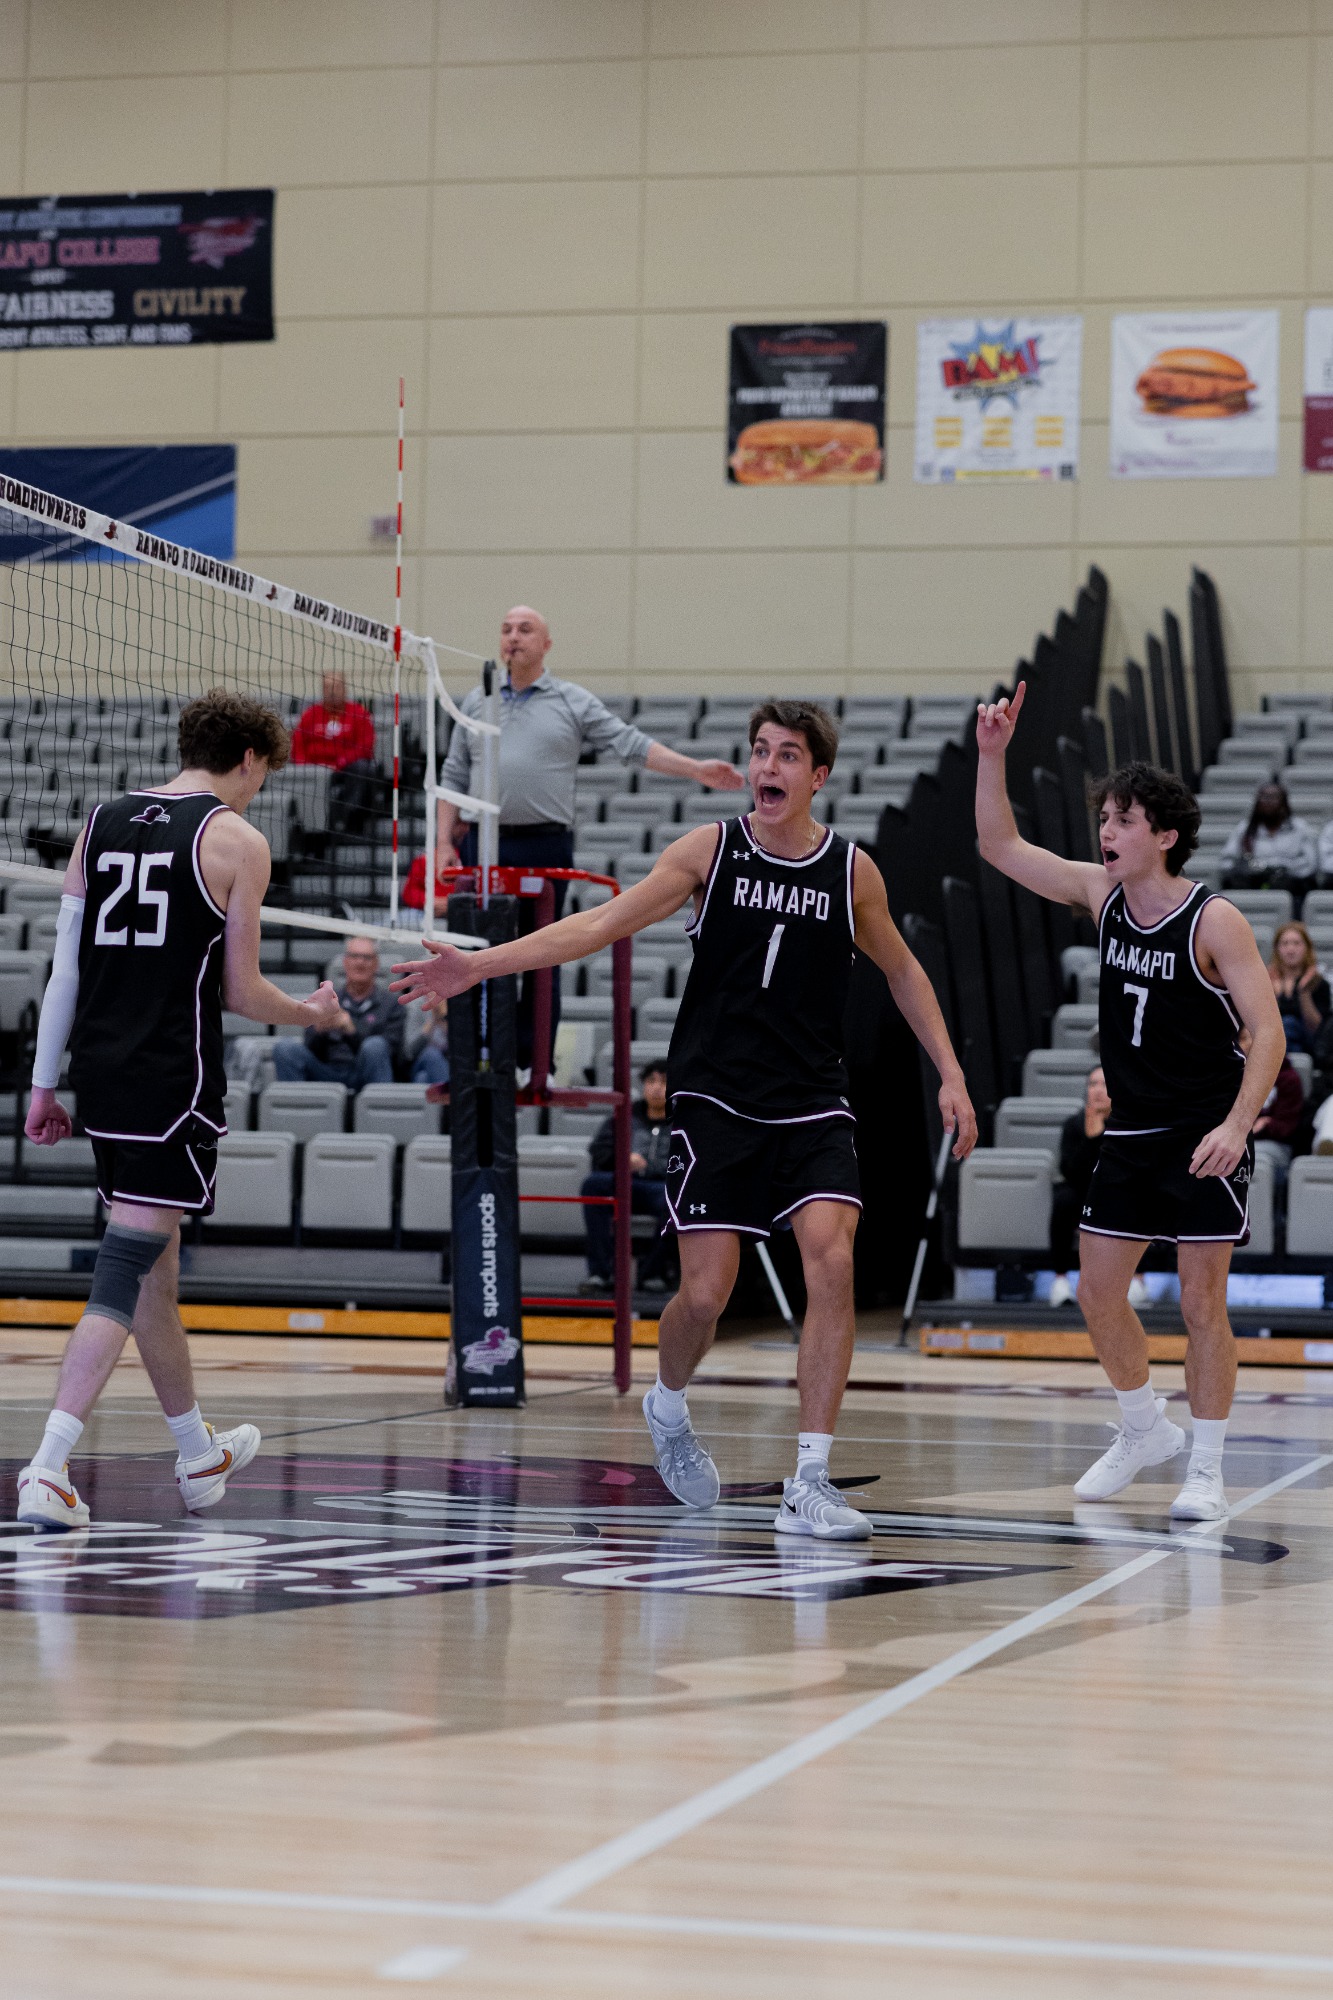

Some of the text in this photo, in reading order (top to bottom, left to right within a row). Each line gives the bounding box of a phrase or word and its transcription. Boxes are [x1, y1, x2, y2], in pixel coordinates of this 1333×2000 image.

[0, 241, 51, 269] APO
[133, 287, 247, 318] CIVILITY
[0, 476, 87, 529] ROADRUNNERS
[136, 532, 254, 593] RAMAPO ROADRUNNERS
[94, 851, 174, 947] 25
[733, 877, 830, 921] RAMAPO
[762, 924, 785, 989] 1
[1105, 937, 1176, 980] RAMAPO
[1123, 982, 1149, 1047] 7
[478, 1193, 500, 1318] sports imports
[0, 1521, 1012, 1598] OLLEGE
